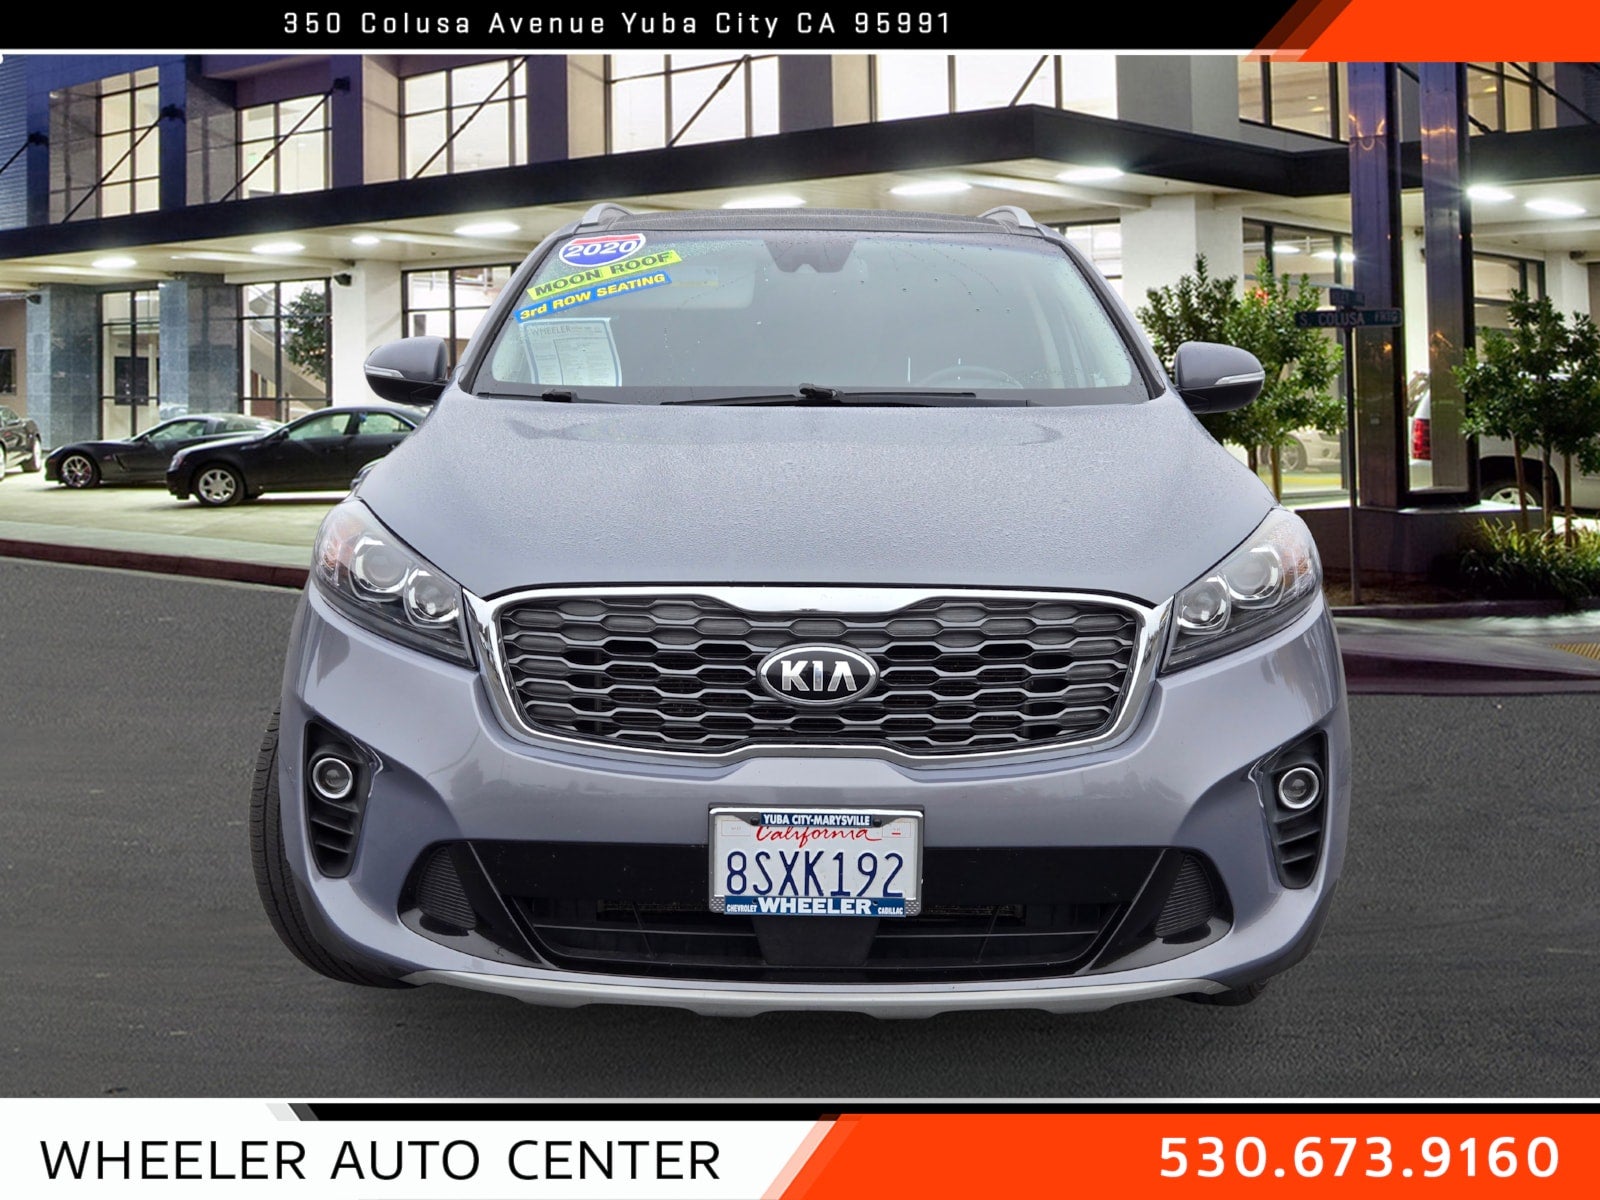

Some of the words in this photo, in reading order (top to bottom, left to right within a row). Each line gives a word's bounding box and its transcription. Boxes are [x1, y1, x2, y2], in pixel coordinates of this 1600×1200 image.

[566, 240, 636, 257] 2020
[534, 269, 600, 296] MOON
[610, 252, 671, 274] ROOF
[520, 303, 548, 320] 3rd
[552, 291, 591, 310] ROW
[597, 273, 665, 297] SEATING
[1318, 312, 1365, 326] COLUSA
[530, 325, 572, 336] WHEELER
[781, 660, 857, 691] KIA
[763, 813, 789, 825] YUBA
[791, 814, 871, 826] CITY-MARYSVILLE
[756, 825, 882, 848] California
[727, 851, 903, 897] 8SXK192
[726, 903, 758, 913] CHEVROLET
[759, 897, 872, 915] WHEELER
[877, 906, 903, 915] CADILLAC
